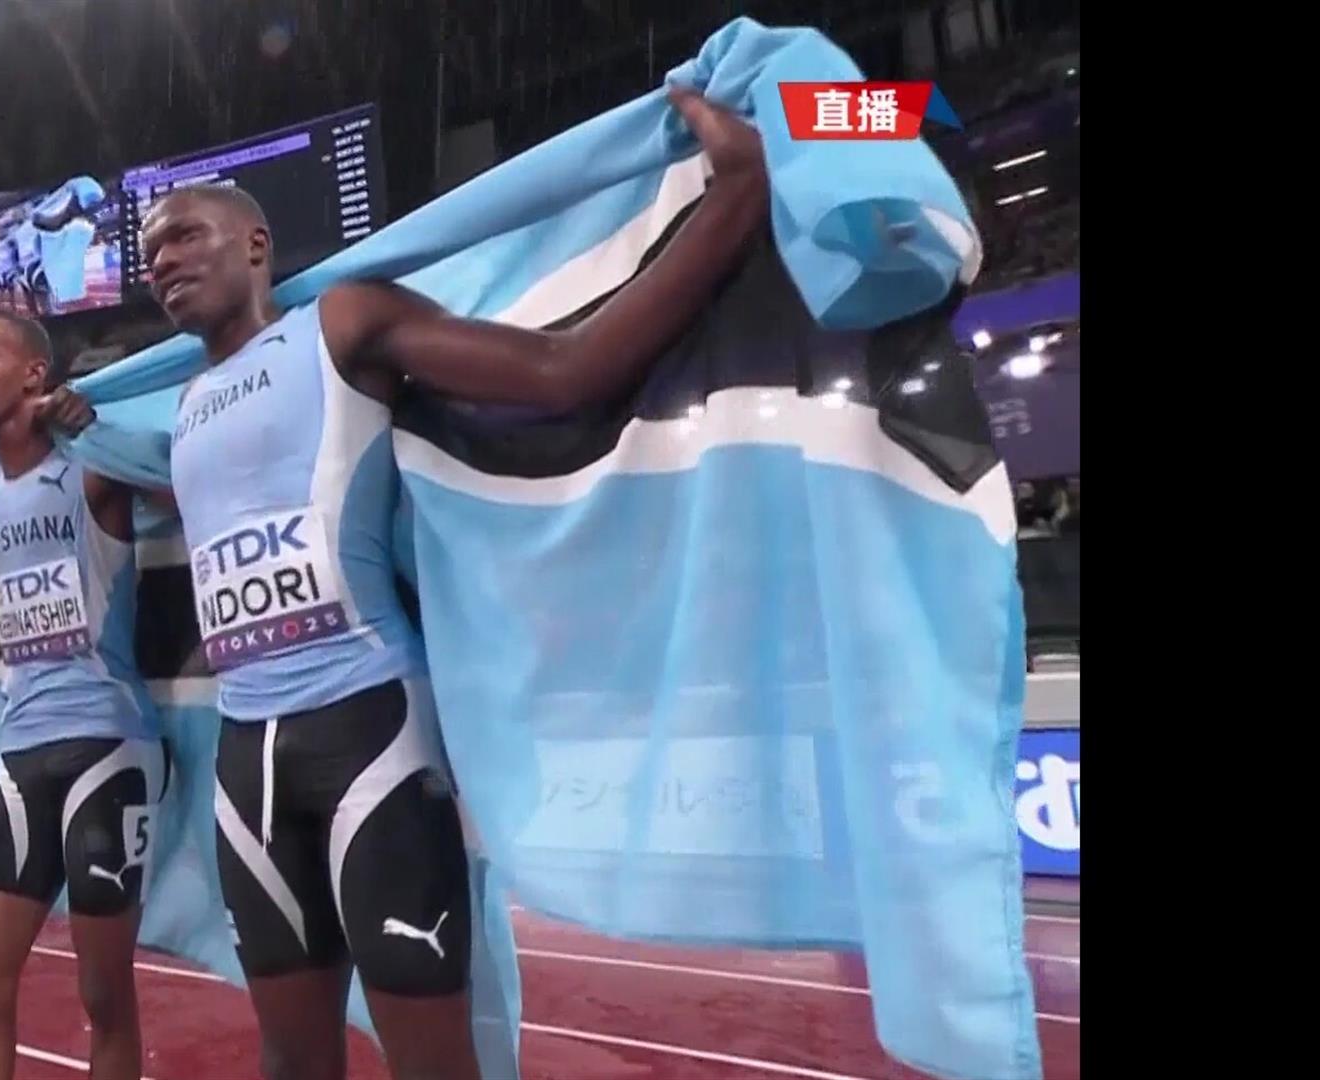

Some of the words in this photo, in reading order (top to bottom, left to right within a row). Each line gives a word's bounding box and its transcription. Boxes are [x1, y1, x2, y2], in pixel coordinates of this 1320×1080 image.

[209, 515, 309, 575] TDK
[2, 563, 69, 603] TDK
[201, 562, 320, 632] NDORI
[135, 815, 148, 856] 5
